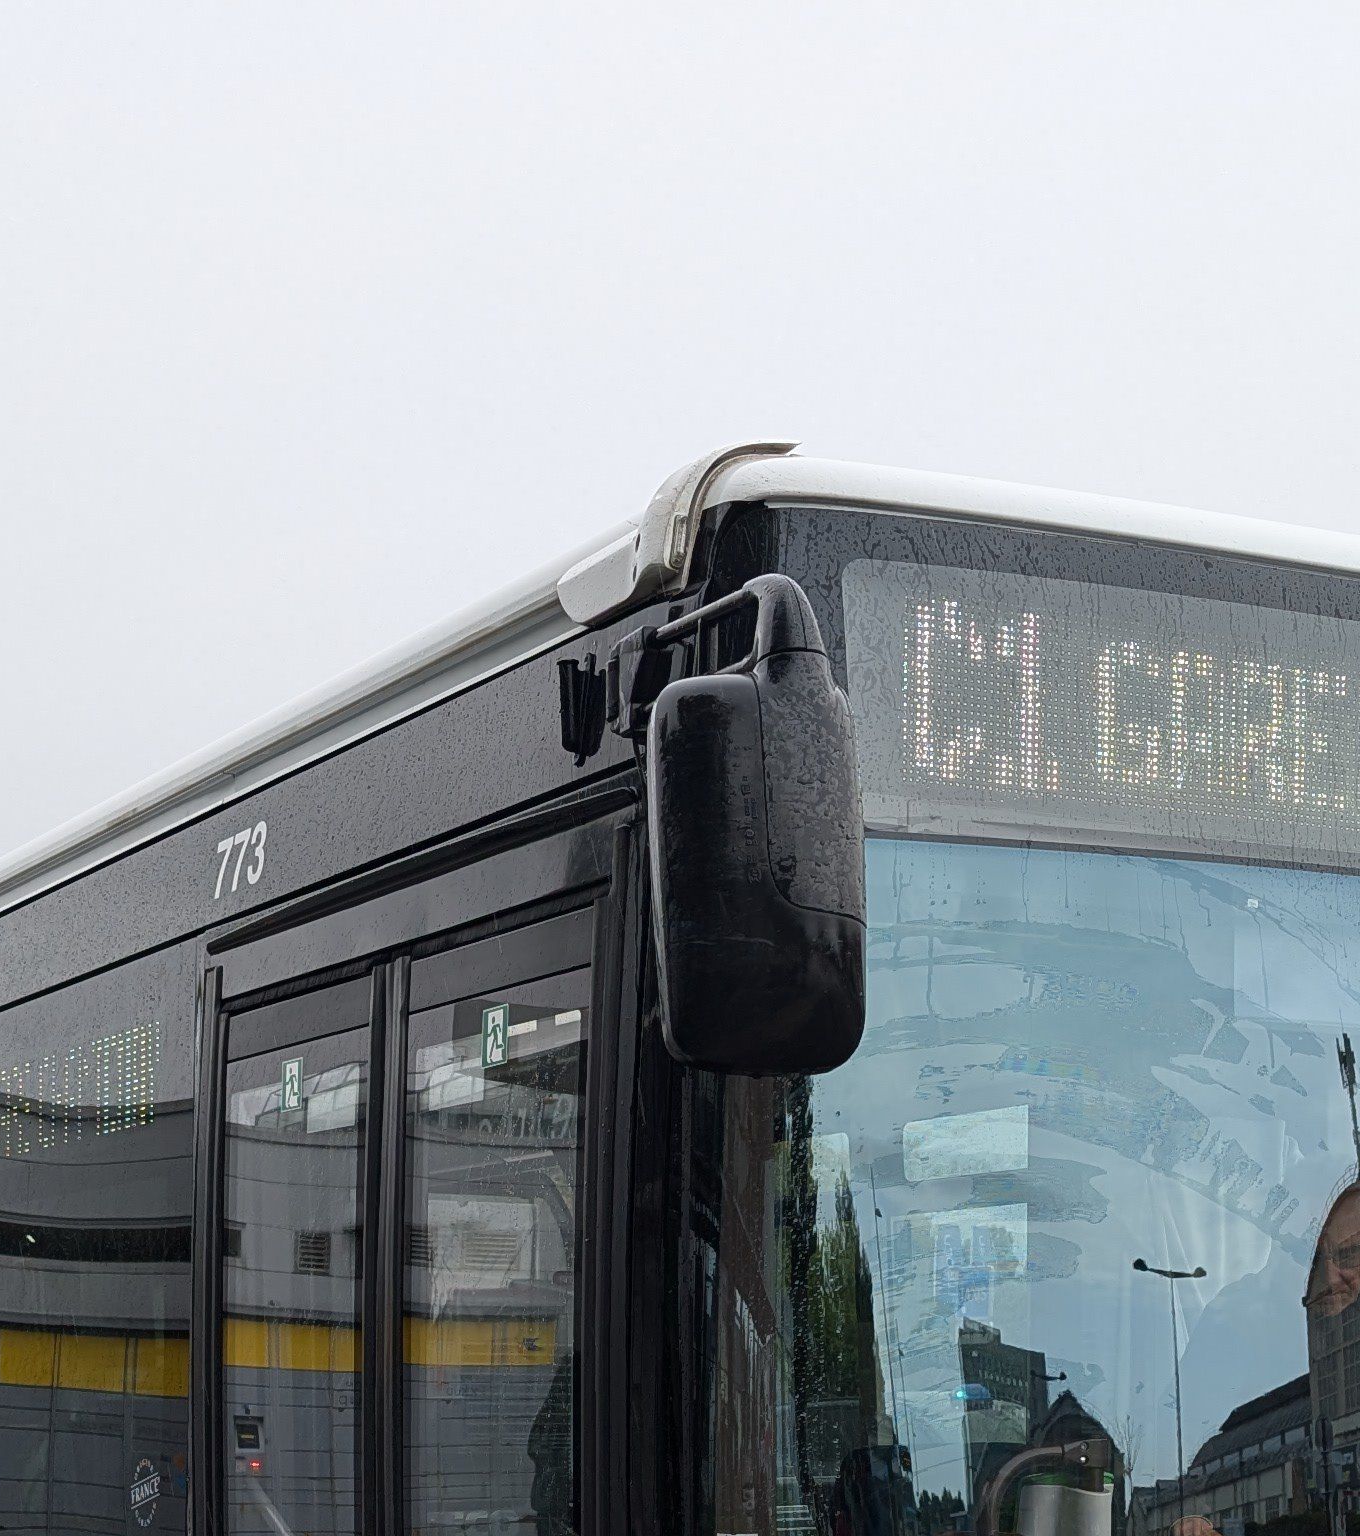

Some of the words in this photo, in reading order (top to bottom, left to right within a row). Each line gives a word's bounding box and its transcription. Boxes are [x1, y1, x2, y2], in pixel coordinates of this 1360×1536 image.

[914, 595, 1061, 793] C1
[1094, 639, 1349, 809] GARE
[214, 820, 268, 900] 773
[130, 1476, 160, 1505] FRANCE
